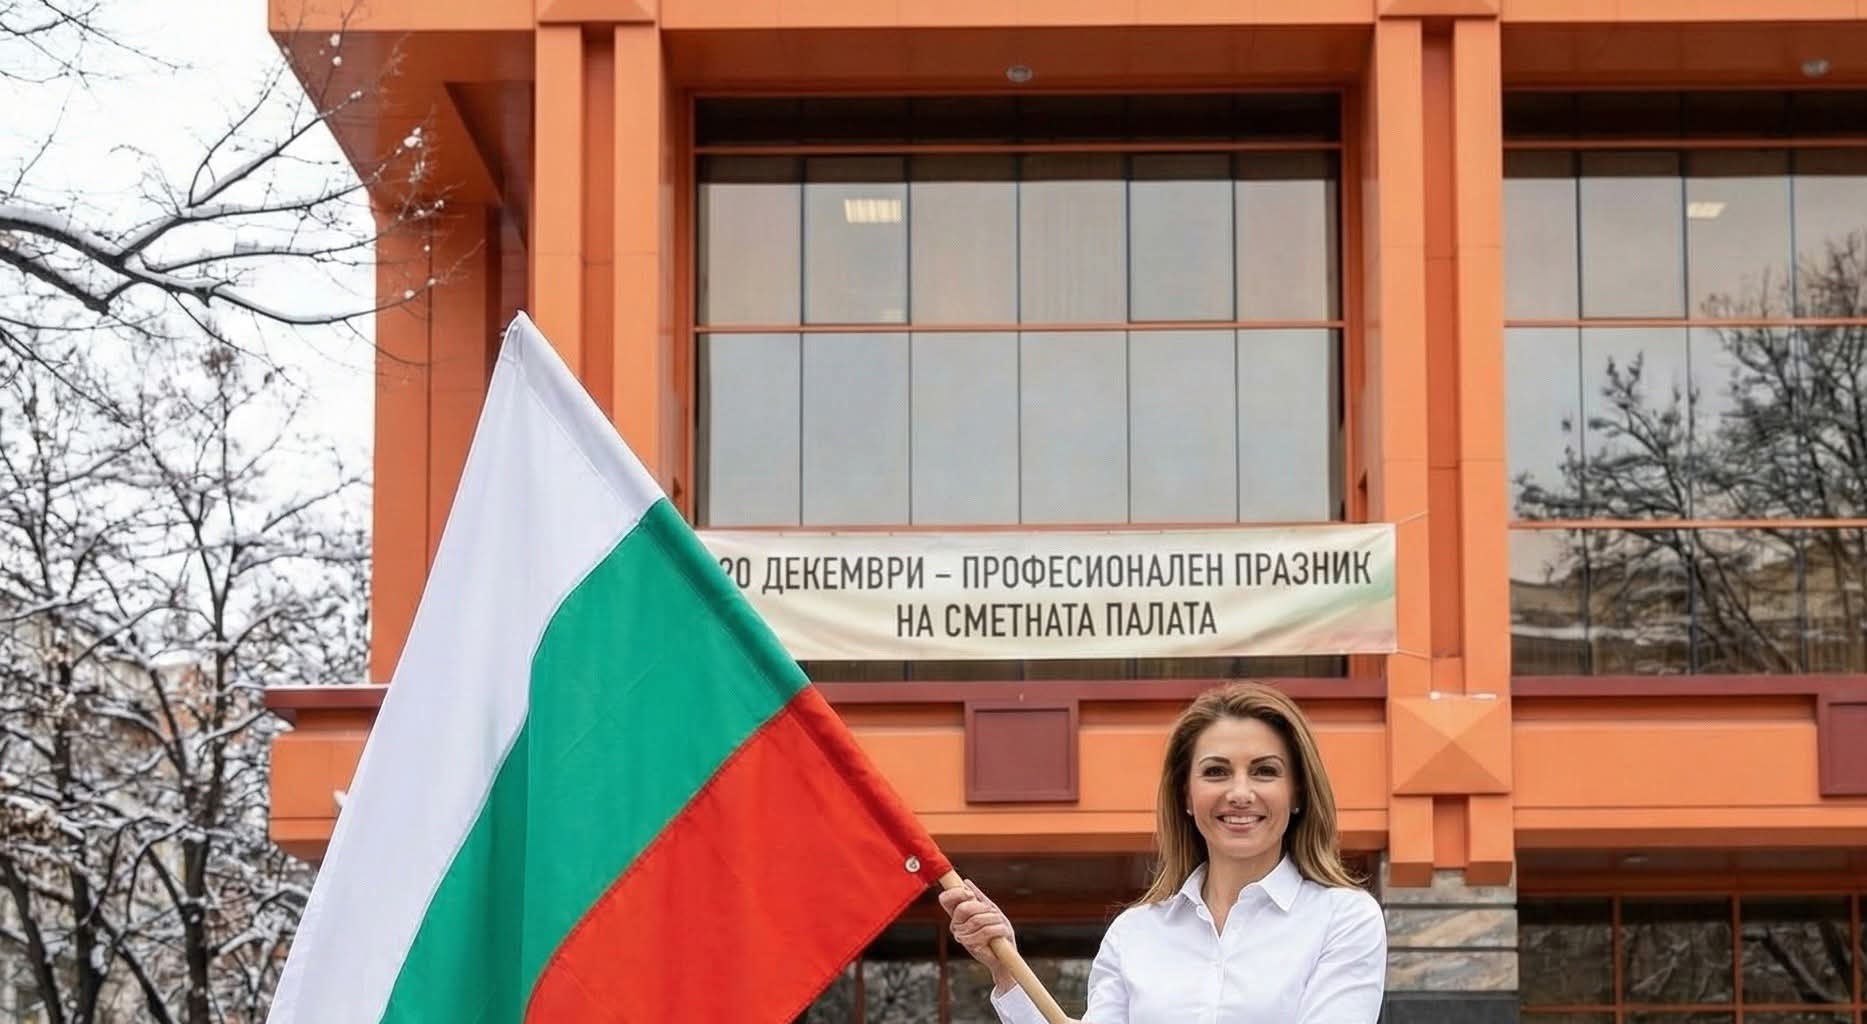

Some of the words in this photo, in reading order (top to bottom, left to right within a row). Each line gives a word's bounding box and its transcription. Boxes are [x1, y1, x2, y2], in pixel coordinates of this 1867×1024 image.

[761, 556, 924, 595] ДЕКЕМВРИ
[962, 552, 1224, 590] ПРОФЕСИОНАЛЕН
[1234, 550, 1372, 587] ПРАЗНИК
[896, 603, 934, 638] НА
[944, 602, 1097, 638] СМЕТНАТА
[1105, 601, 1218, 637] ПАЛАТА
